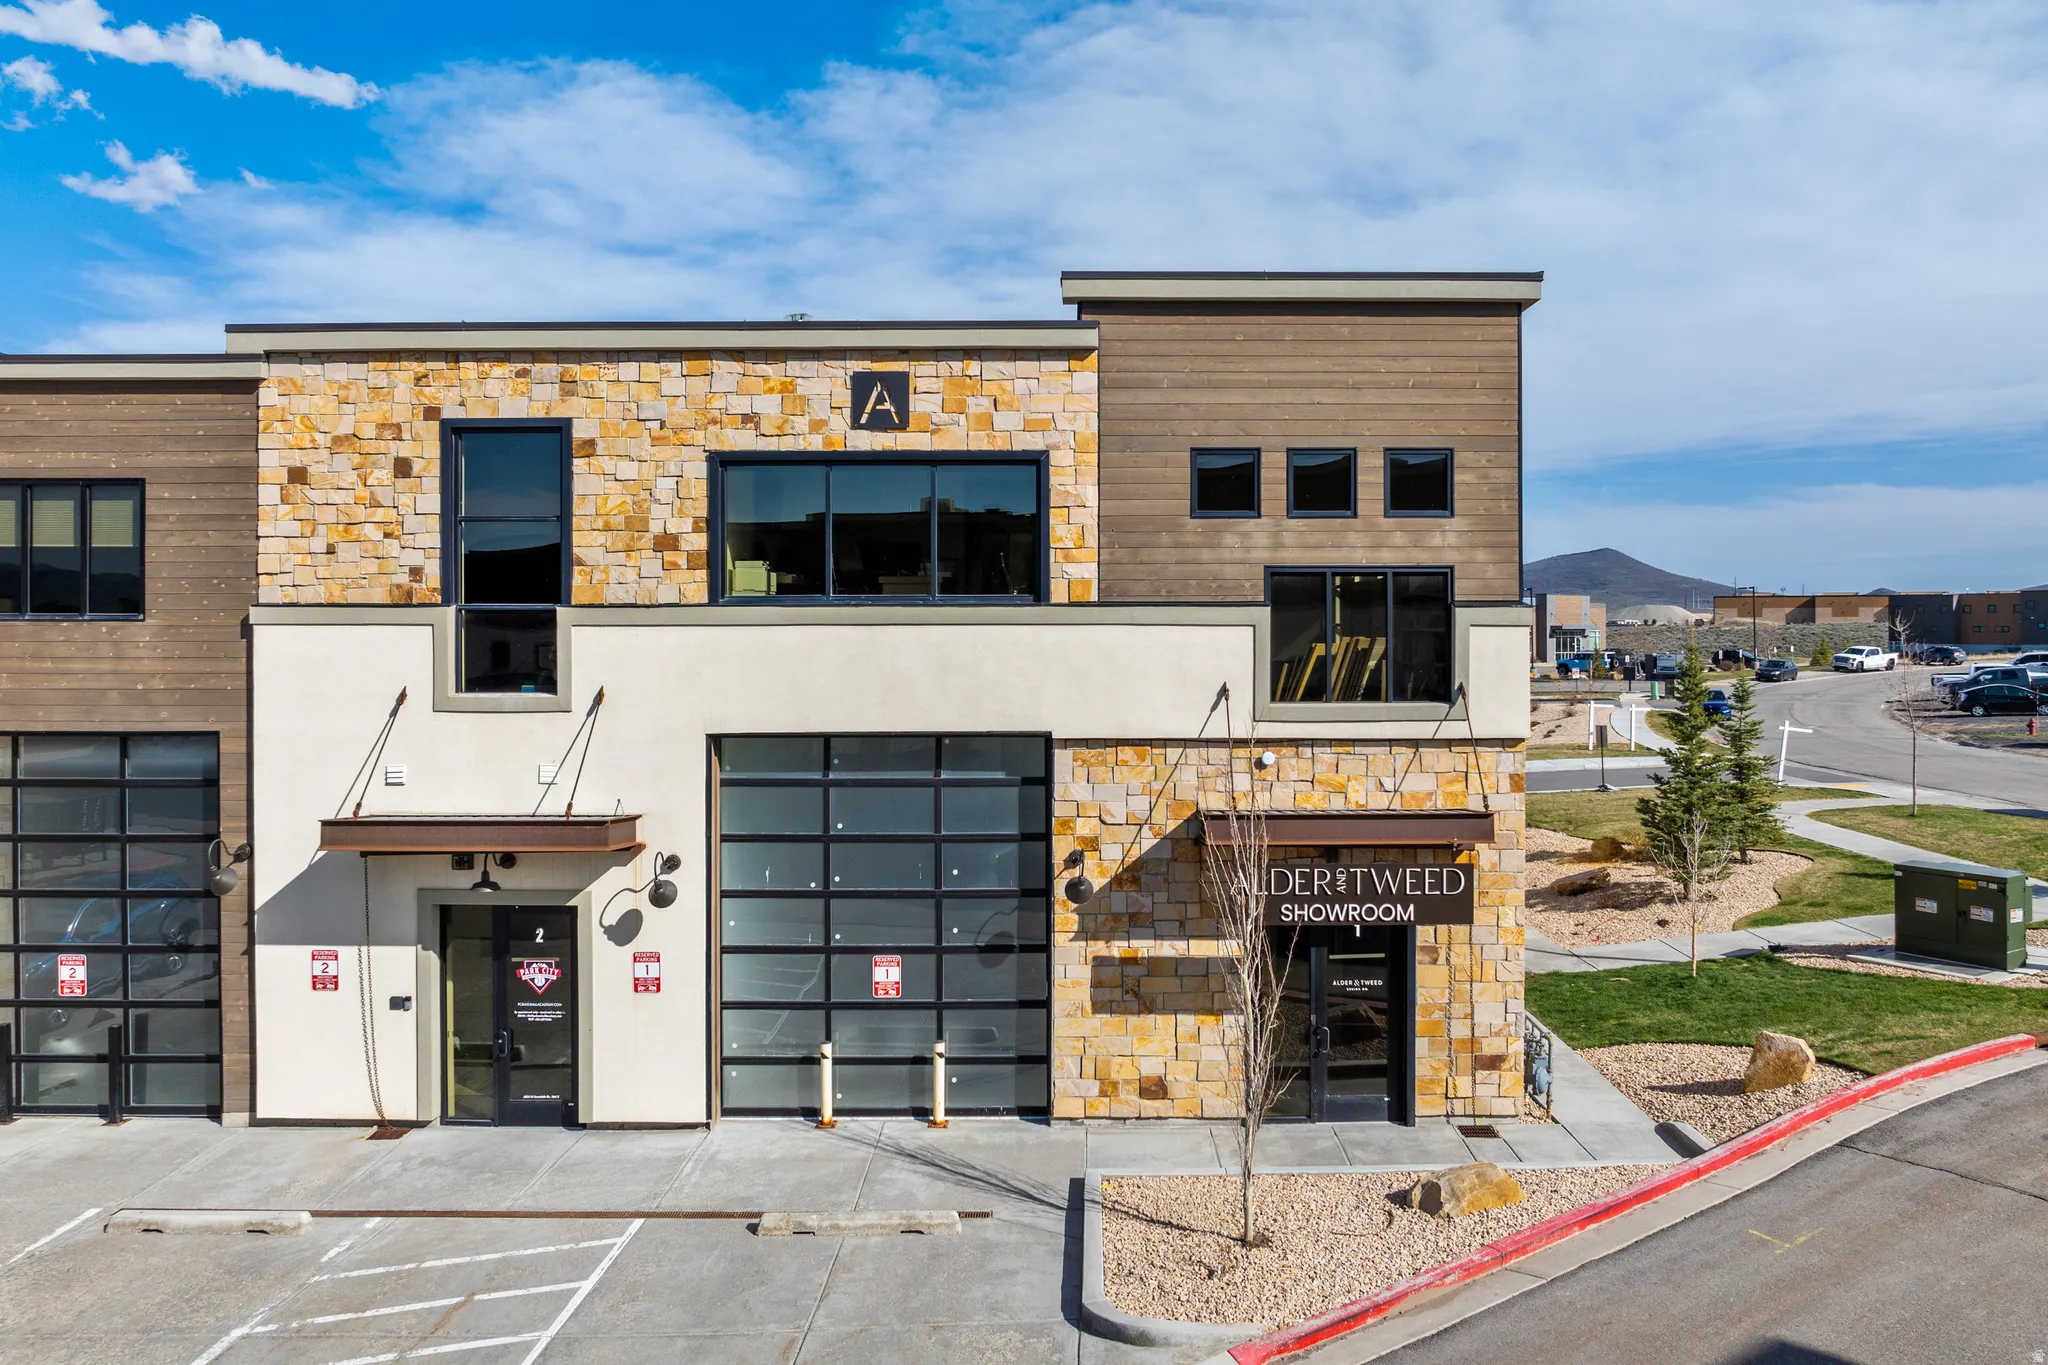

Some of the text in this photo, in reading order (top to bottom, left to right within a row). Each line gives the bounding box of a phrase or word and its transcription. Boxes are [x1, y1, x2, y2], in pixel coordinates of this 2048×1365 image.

[1336, 868, 1346, 894] AND
[1350, 868, 1465, 895] TWEED
[1280, 904, 1415, 922] SHOWROOM
[536, 928, 544, 943] 2
[1354, 924, 1360, 937] 1
[69, 967, 76, 978] 2
[321, 962, 329, 973] 2
[520, 967, 558, 975] PARK CITY
[645, 964, 649, 975] 1
[885, 969, 889, 980] 1
